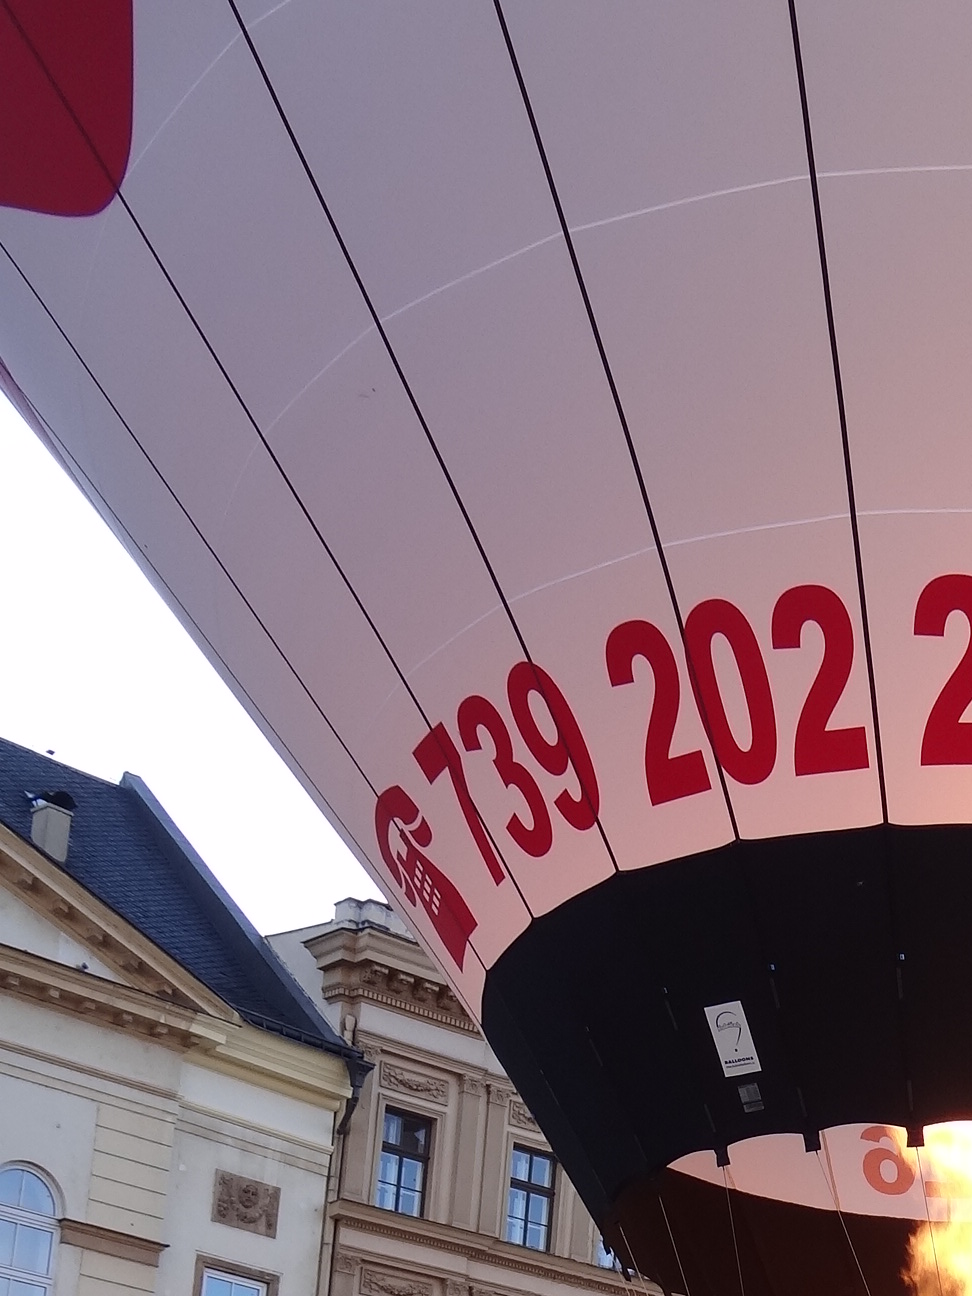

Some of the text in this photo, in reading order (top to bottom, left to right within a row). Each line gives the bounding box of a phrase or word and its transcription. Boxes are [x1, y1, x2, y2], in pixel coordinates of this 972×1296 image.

[412, 661, 600, 884] 739
[605, 584, 870, 807] 202
[724, 1056, 754, 1065] BALLOONS
